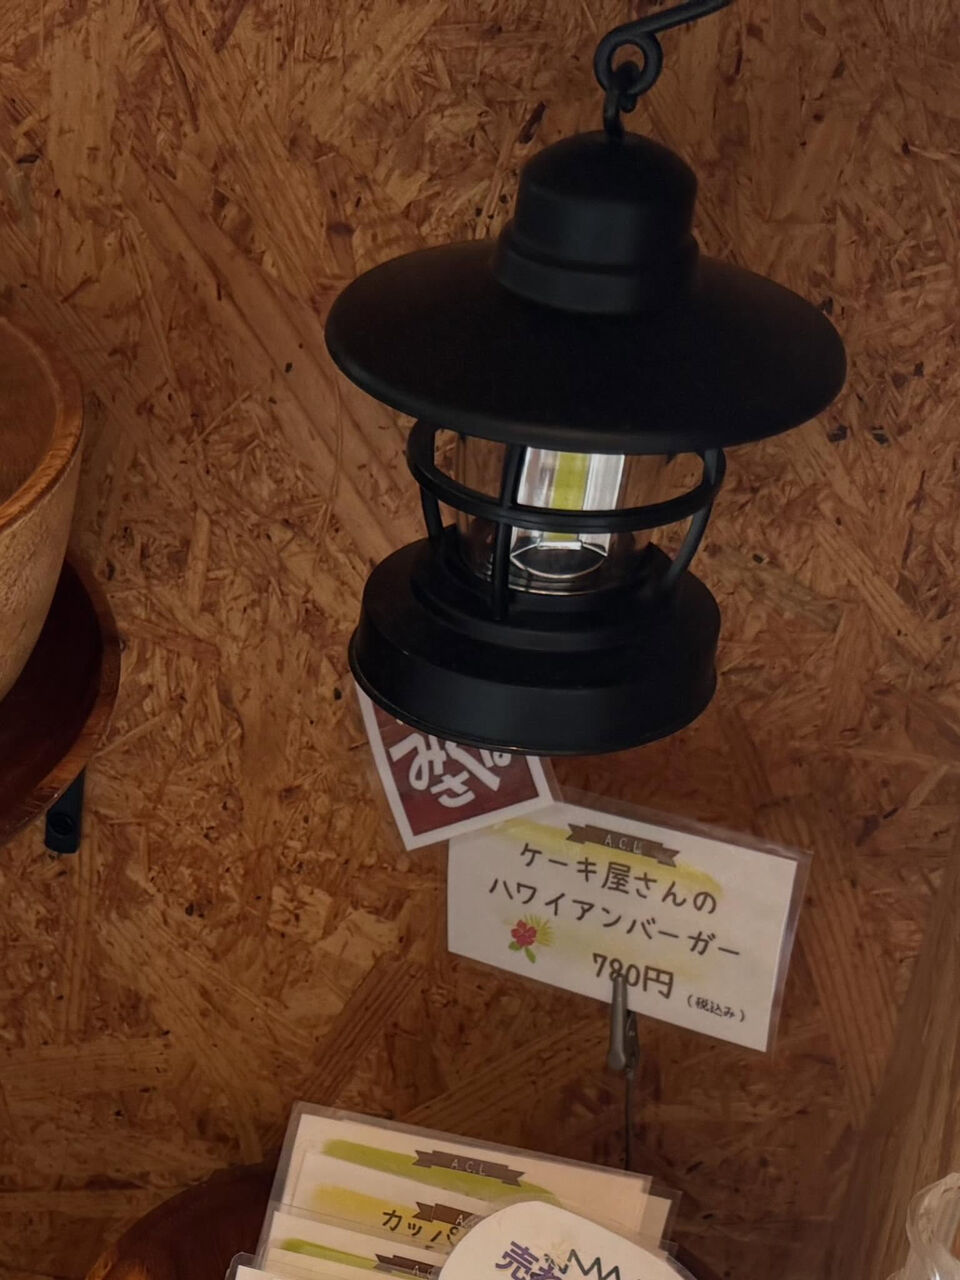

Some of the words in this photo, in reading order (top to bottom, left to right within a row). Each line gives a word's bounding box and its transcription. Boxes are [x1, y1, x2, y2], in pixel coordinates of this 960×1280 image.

[520, 842, 718, 915] ケーキ屋さんの
[489, 877, 741, 957] ハワイアンバーガー
[592, 952, 675, 999] 780円
